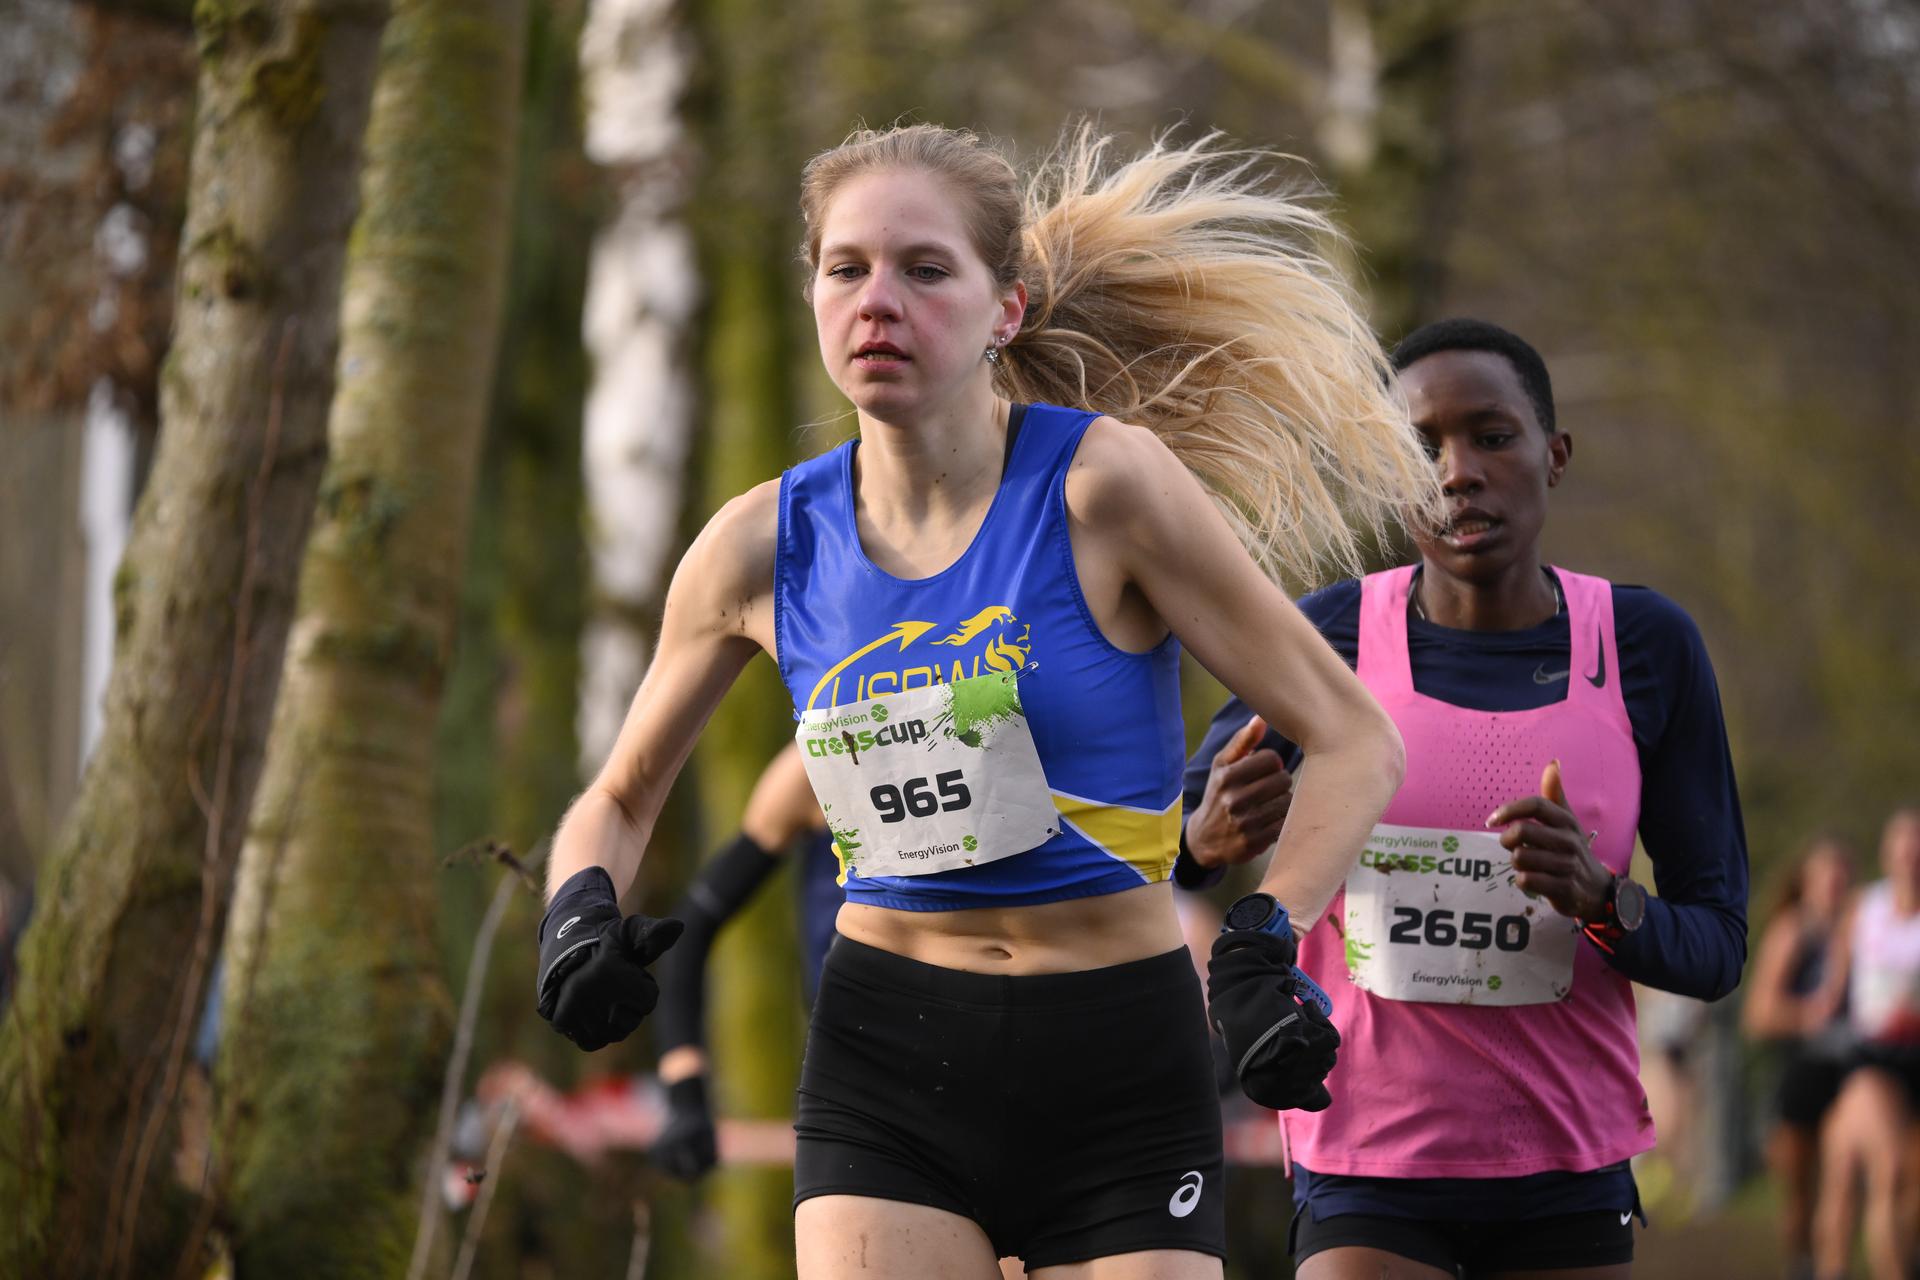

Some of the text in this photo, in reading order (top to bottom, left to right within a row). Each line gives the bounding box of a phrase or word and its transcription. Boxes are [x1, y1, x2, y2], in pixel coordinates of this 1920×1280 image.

[803, 712, 868, 733] nergyVision
[870, 769, 972, 824] 965
[898, 841, 960, 860] EnergyVision
[1389, 907, 1530, 952] 2650
[1412, 973, 1482, 987] EnergyVision
